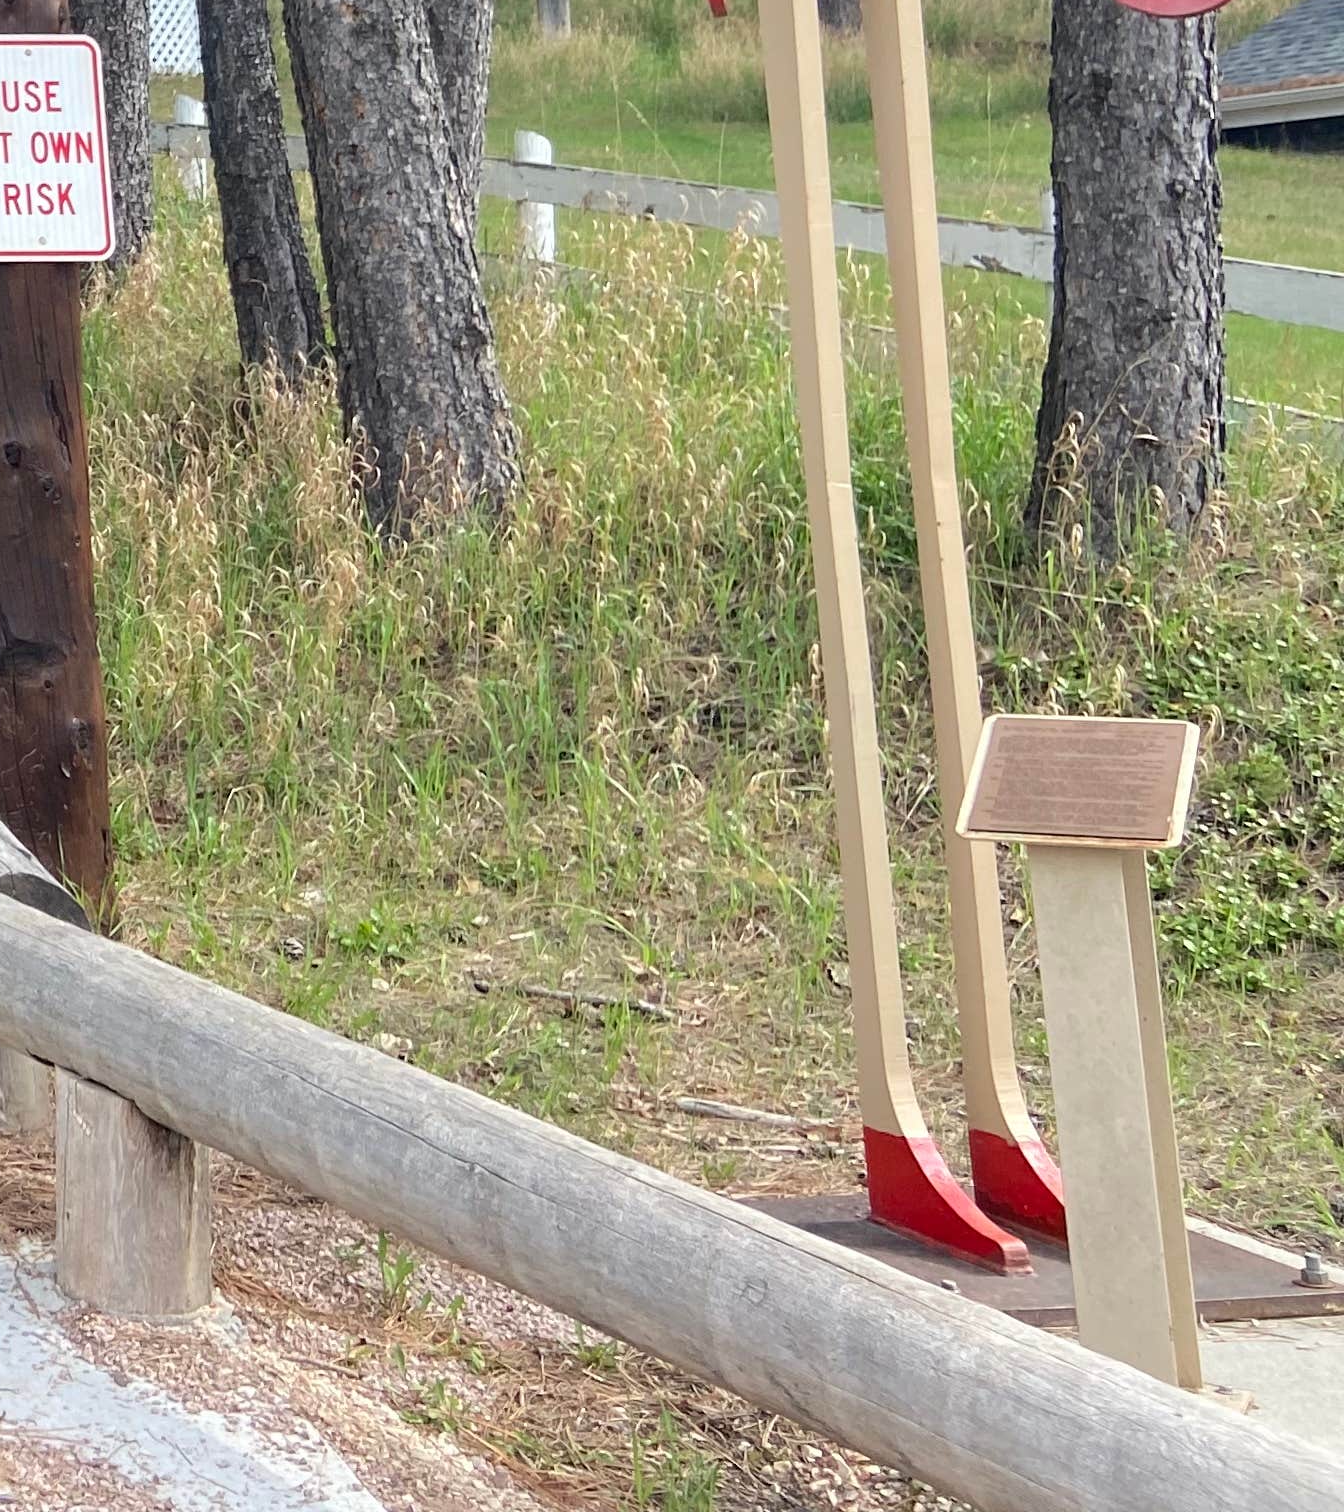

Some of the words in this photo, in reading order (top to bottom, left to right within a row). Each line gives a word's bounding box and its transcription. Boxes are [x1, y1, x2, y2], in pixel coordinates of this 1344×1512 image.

[1, 81, 62, 112] USE
[31, 131, 94, 164] OWN
[3, 183, 76, 215] RISK
